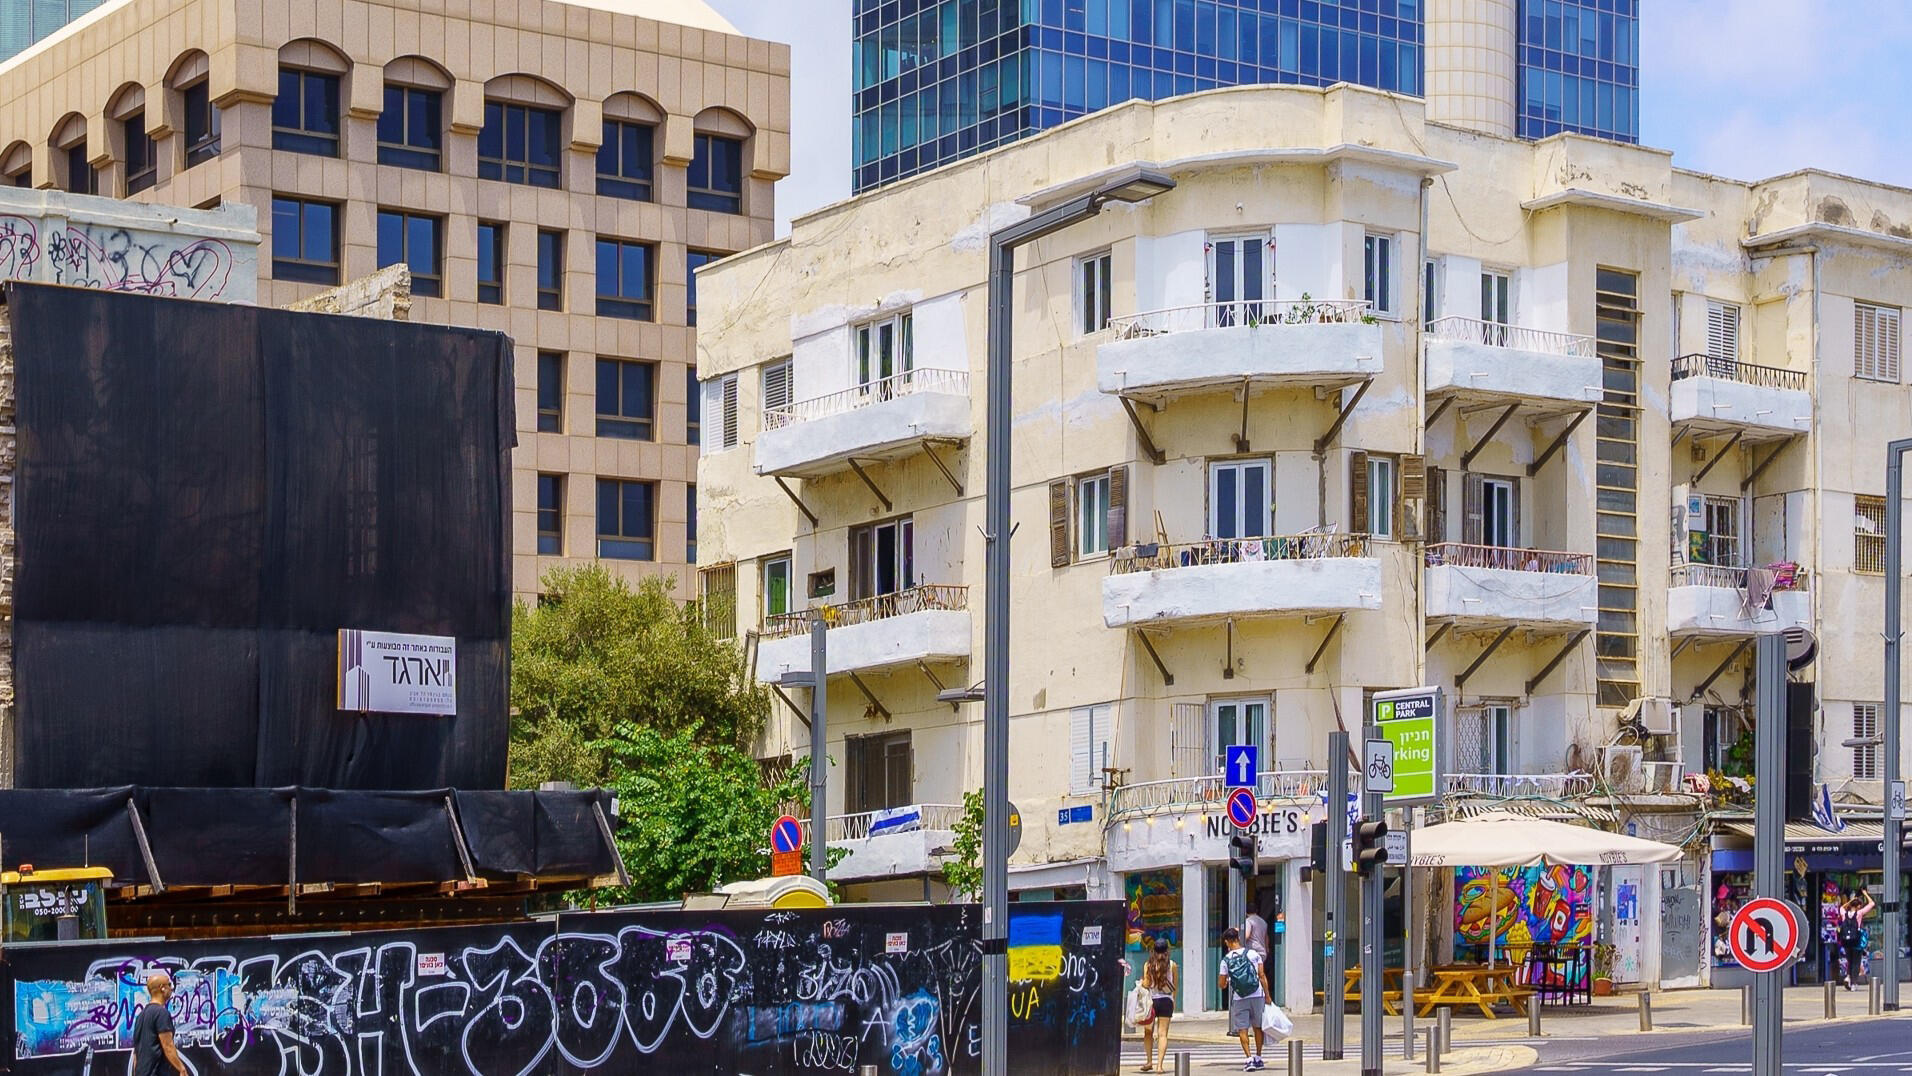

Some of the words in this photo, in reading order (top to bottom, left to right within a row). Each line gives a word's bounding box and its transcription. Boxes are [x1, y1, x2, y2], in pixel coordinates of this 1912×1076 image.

[402, 643, 409, 651] זה
[411, 643, 427, 652] באתר
[1395, 699, 1430, 710] CENTRAL
[1395, 709, 1416, 718] PARK
[1400, 730, 1430, 745] חניון
[1394, 747, 1430, 761] rking
[1060, 811, 1068, 822] 35
[1207, 810, 1298, 837] NOBIE'S
[1011, 986, 1040, 1020] UA
